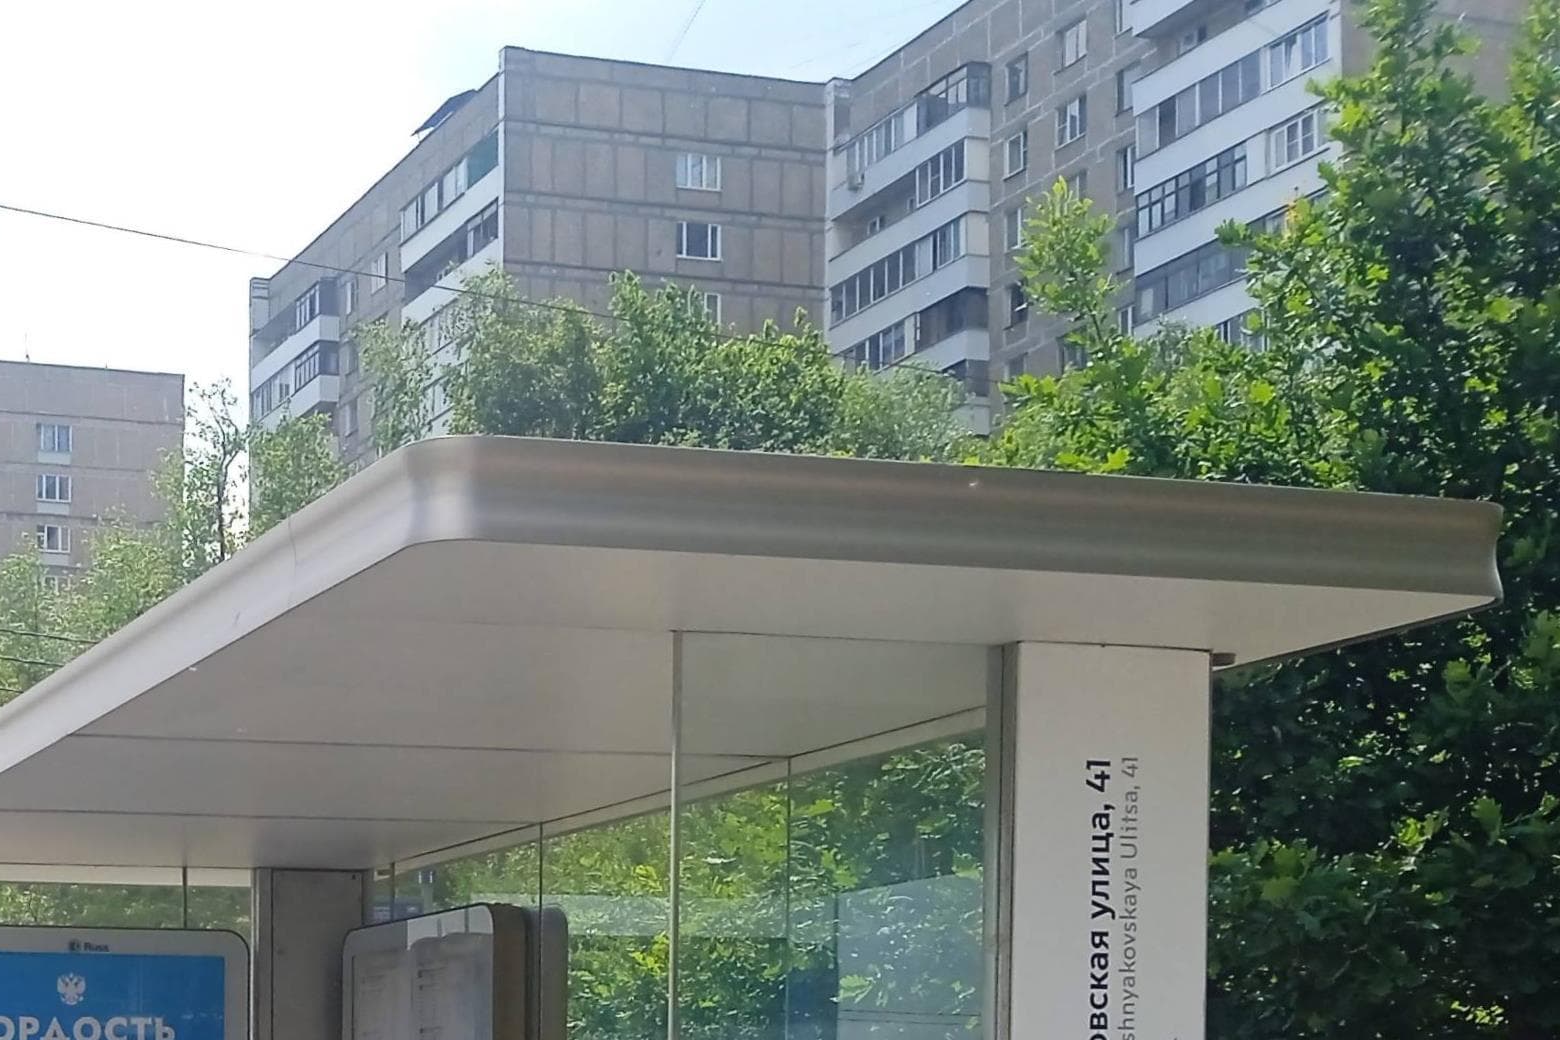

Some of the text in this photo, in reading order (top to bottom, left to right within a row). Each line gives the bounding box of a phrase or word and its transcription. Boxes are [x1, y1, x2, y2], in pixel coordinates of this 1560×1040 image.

[1085, 759, 1112, 793] 41
[1121, 757, 1139, 778] 41
[1120, 785, 1141, 859] Ulitsa,
[1090, 803, 1116, 920] улица,
